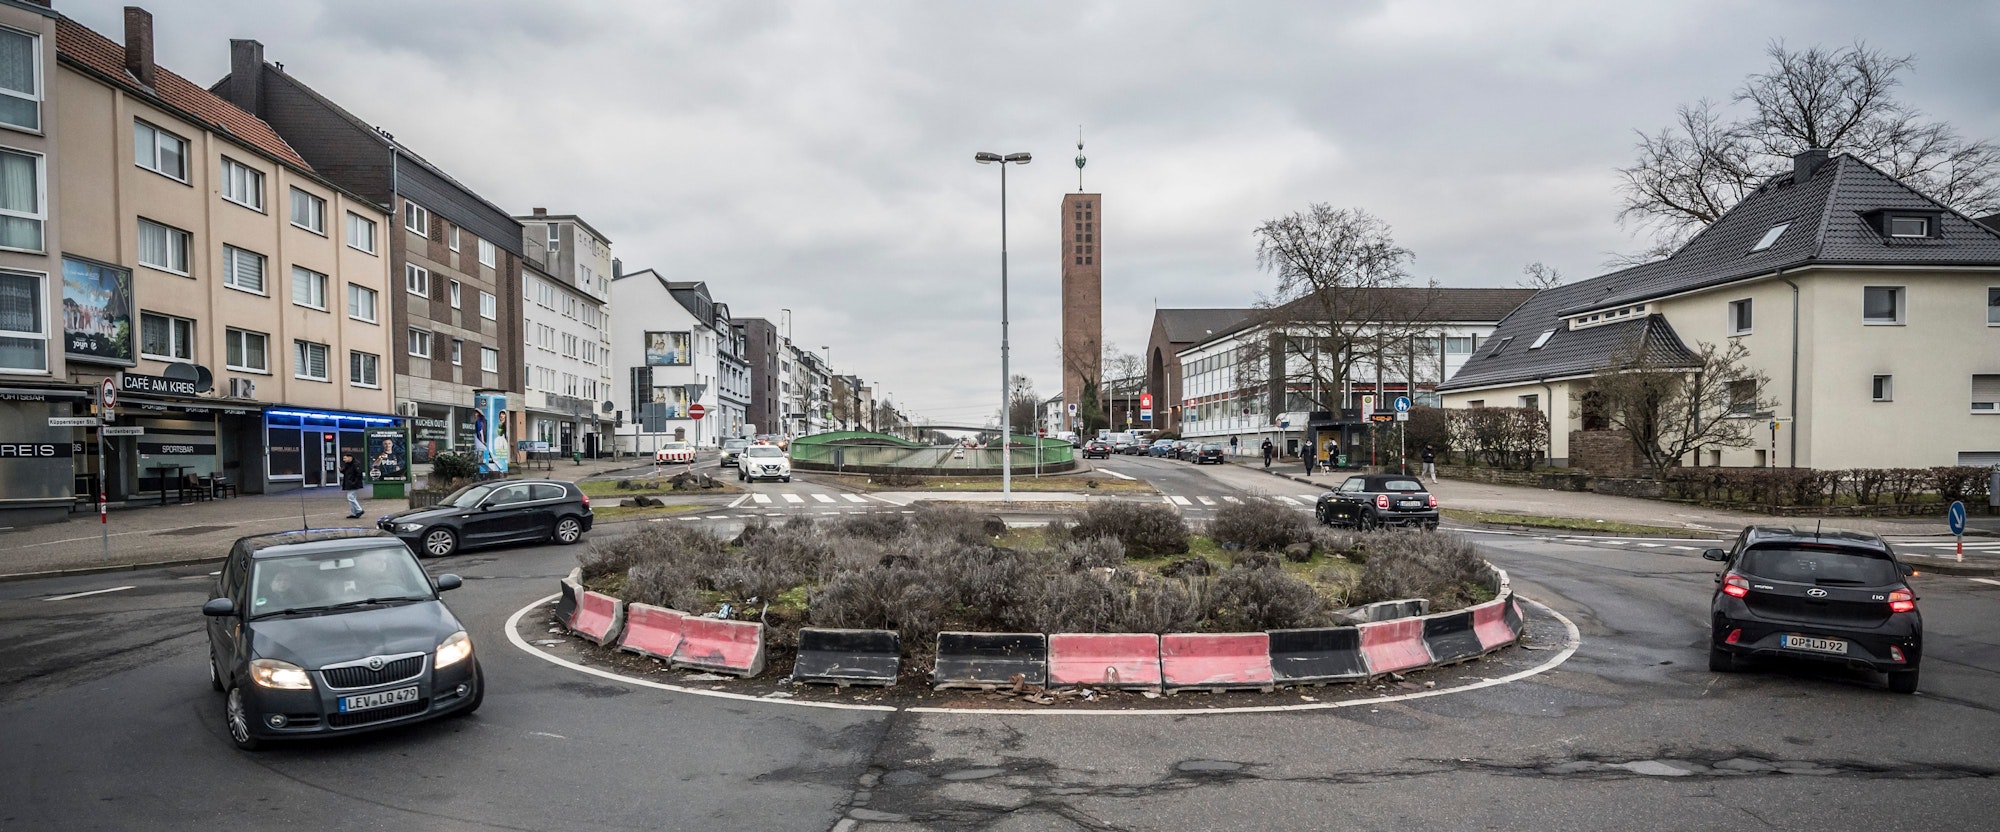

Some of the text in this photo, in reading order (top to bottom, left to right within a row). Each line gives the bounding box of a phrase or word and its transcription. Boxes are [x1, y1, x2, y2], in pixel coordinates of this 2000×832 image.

[124, 376, 195, 394] CAFÉ AM KREIS
[162, 445, 194, 453] SPORTSBAR
[1791, 638, 1843, 651] OP LD 92
[348, 689, 416, 709] LEV LQ 479
